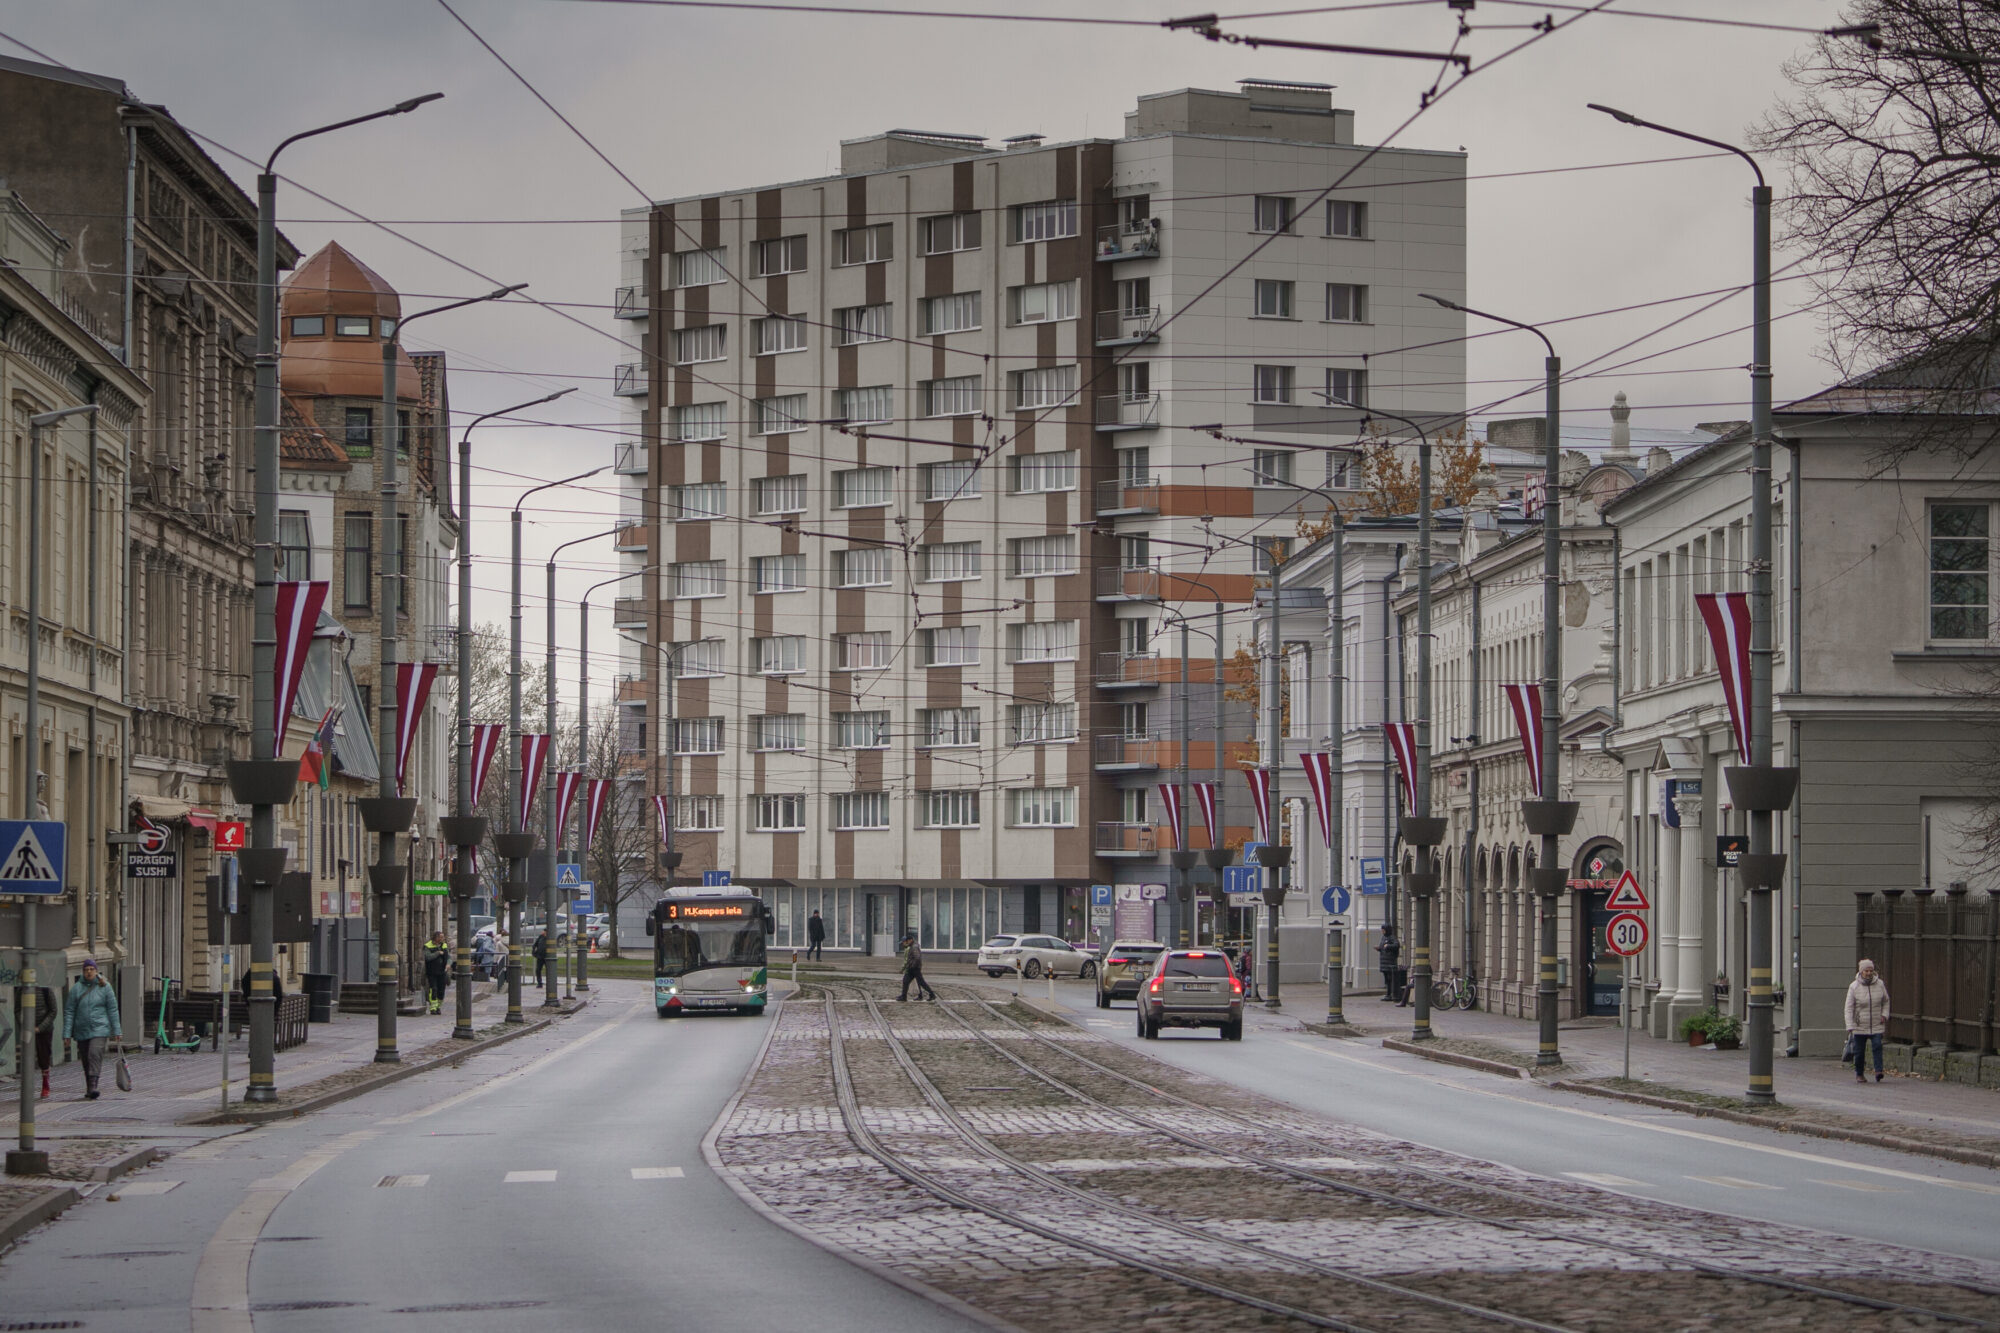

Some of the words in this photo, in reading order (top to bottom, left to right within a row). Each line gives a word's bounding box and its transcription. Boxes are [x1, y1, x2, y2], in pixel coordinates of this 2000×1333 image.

[129, 855, 174, 865] DRAGON
[135, 866, 167, 876] SUSHI
[1097, 887, 1109, 904] P
[670, 905, 677, 918] 3
[725, 906, 742, 914] iela
[1618, 924, 1638, 944] 30
